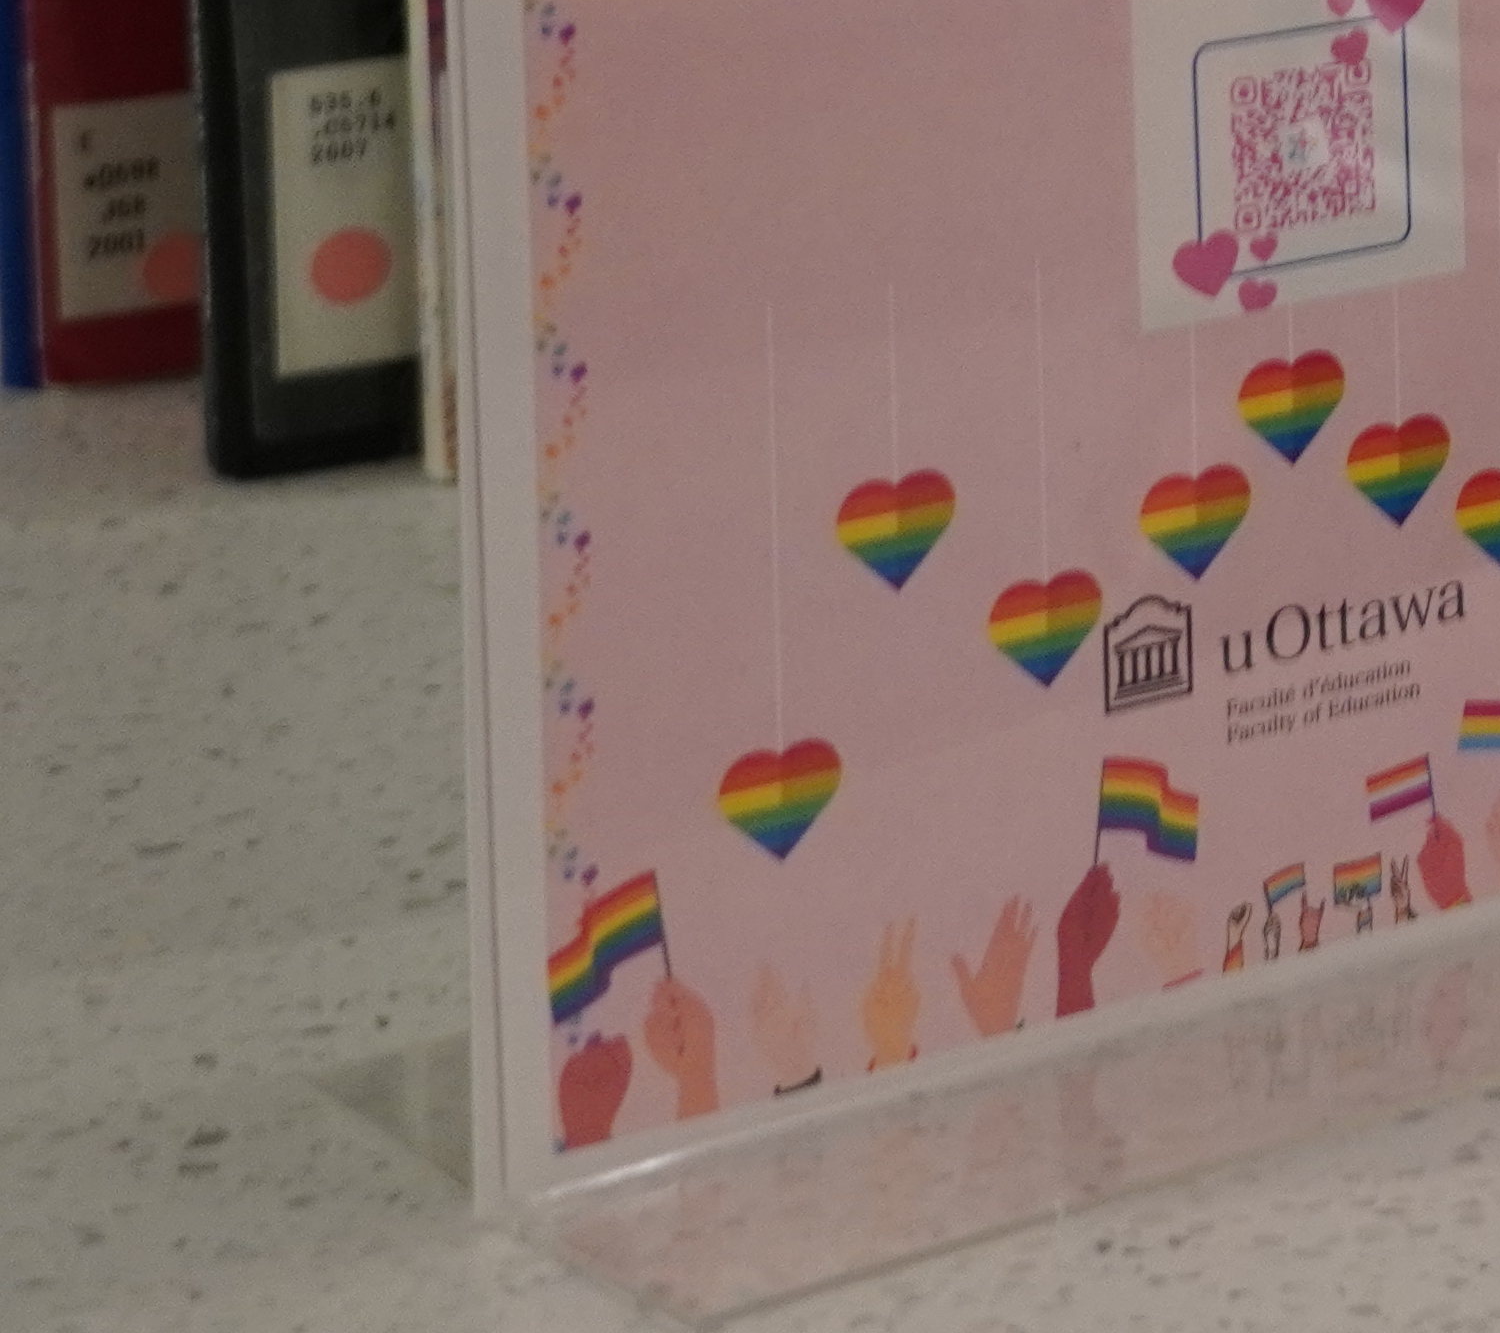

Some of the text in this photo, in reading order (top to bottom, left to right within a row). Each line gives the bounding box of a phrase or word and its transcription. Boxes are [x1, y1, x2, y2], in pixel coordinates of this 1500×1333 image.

[1226, 658, 1412, 721] Faculté d'éducation
[1226, 681, 1421, 746] Faculty of Education
